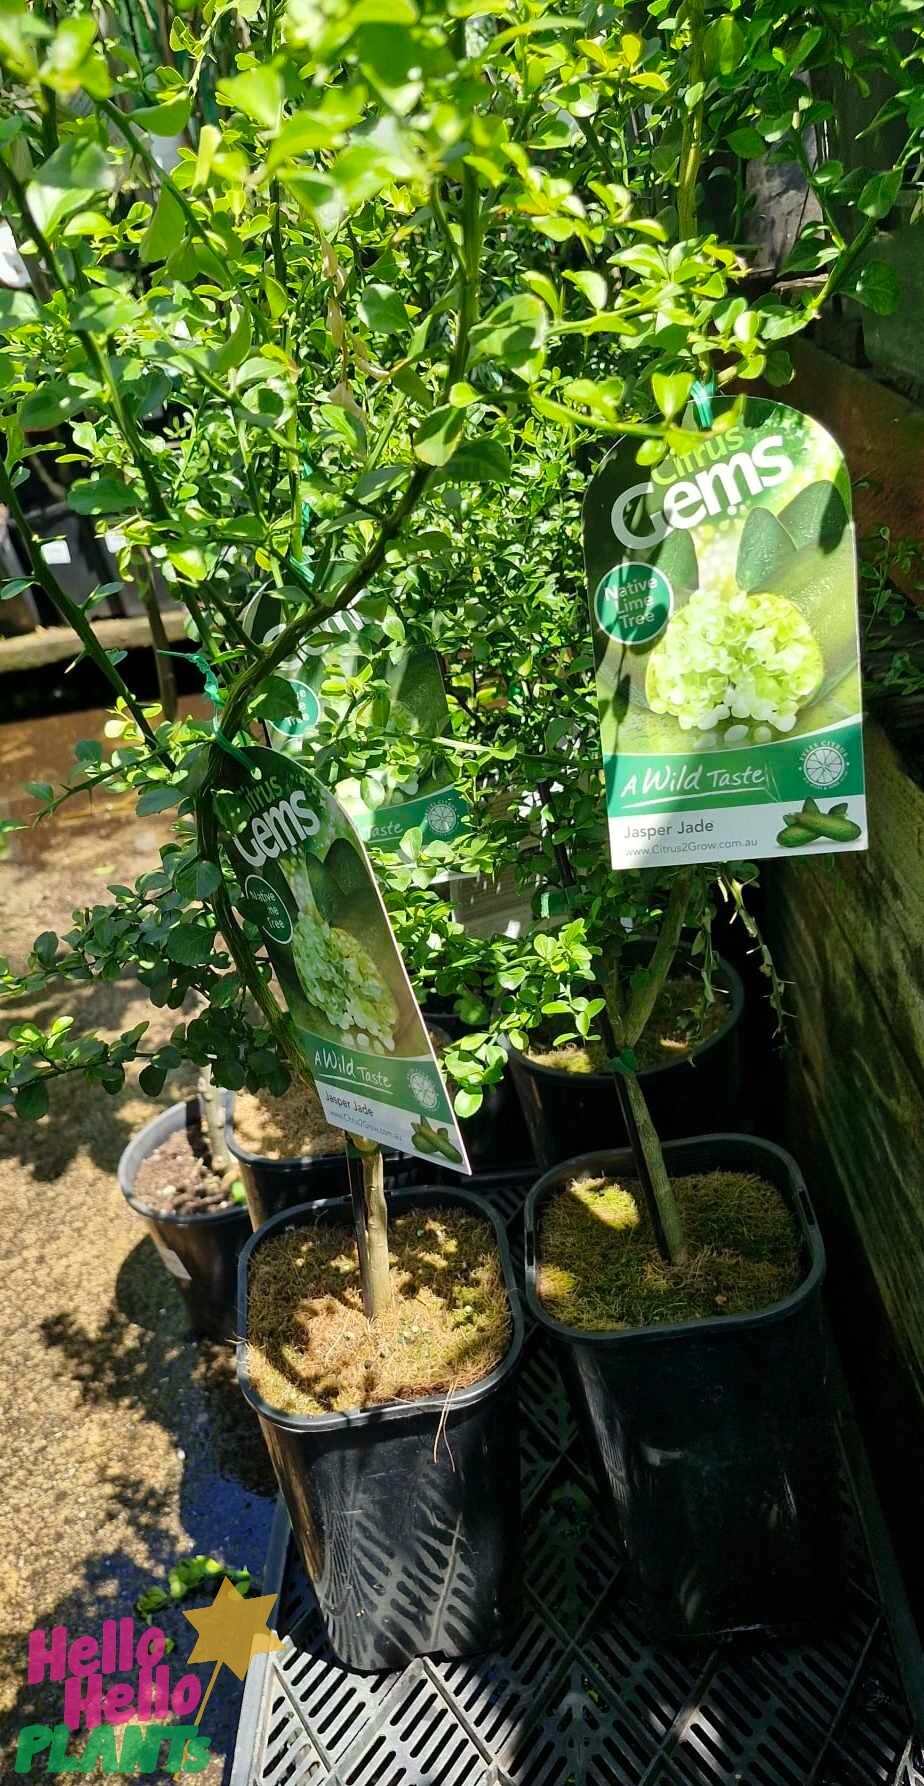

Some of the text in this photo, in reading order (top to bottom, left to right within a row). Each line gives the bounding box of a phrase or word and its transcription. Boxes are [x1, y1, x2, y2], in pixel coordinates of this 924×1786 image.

[611, 434, 794, 550] Gems
[604, 577, 658, 601] Native
[616, 595, 656, 615] Lime
[618, 611, 655, 629] Tree
[620, 763, 765, 798] A Wild Taste
[624, 818, 714, 840] Jasper Jade
[625, 839, 758, 857] www.Citrus2Grow.com.au
[314, 1048, 392, 1088] A Wild Taste
[325, 1090, 374, 1117] Jasper Jade
